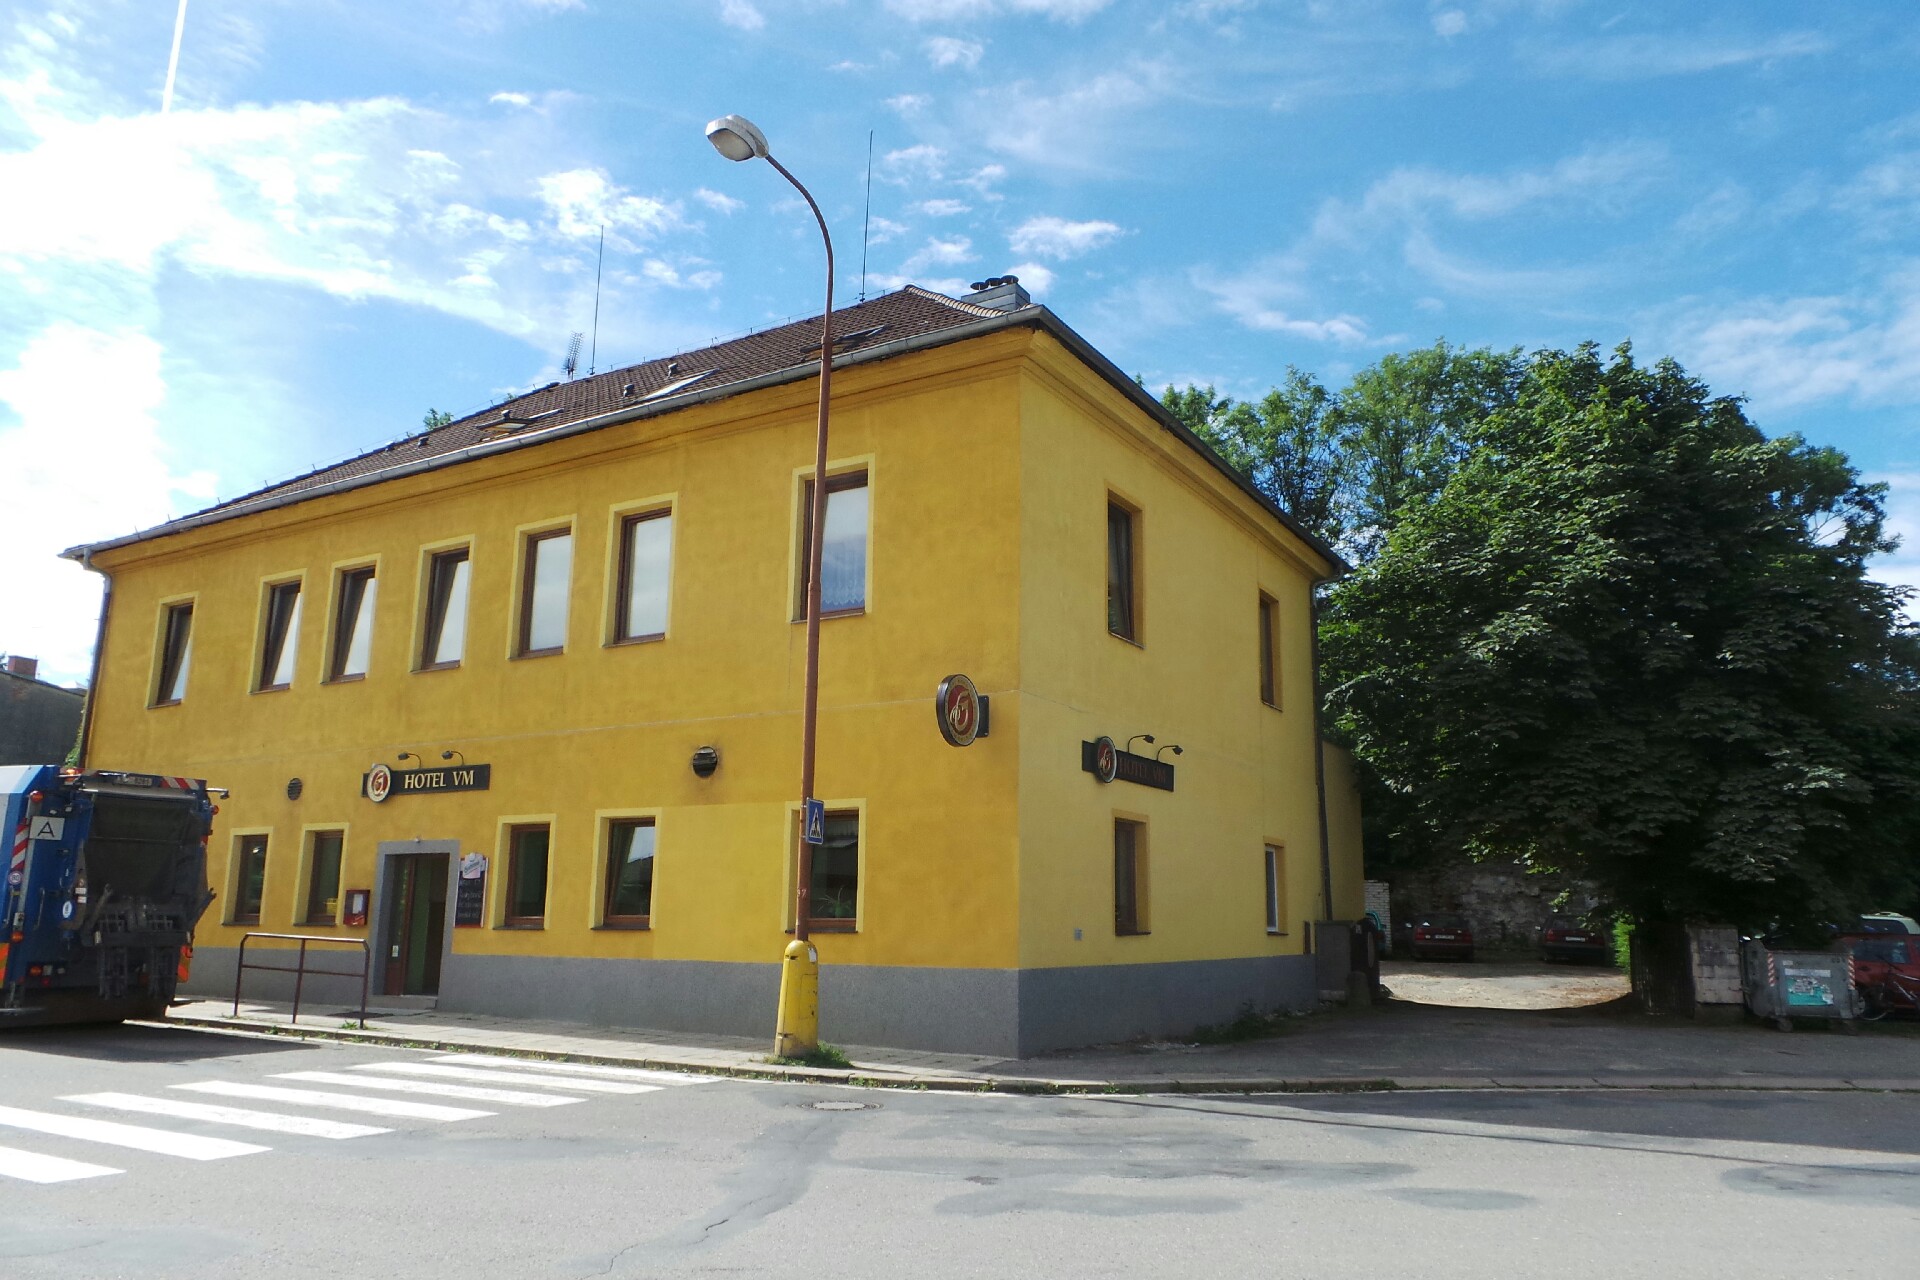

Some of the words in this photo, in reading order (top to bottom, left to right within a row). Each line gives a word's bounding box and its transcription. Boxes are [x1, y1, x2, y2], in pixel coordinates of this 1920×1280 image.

[1119, 757, 1148, 780] HOTEL
[404, 772, 447, 789] HOTEL
[452, 769, 475, 786] VM
[37, 821, 55, 838] A
